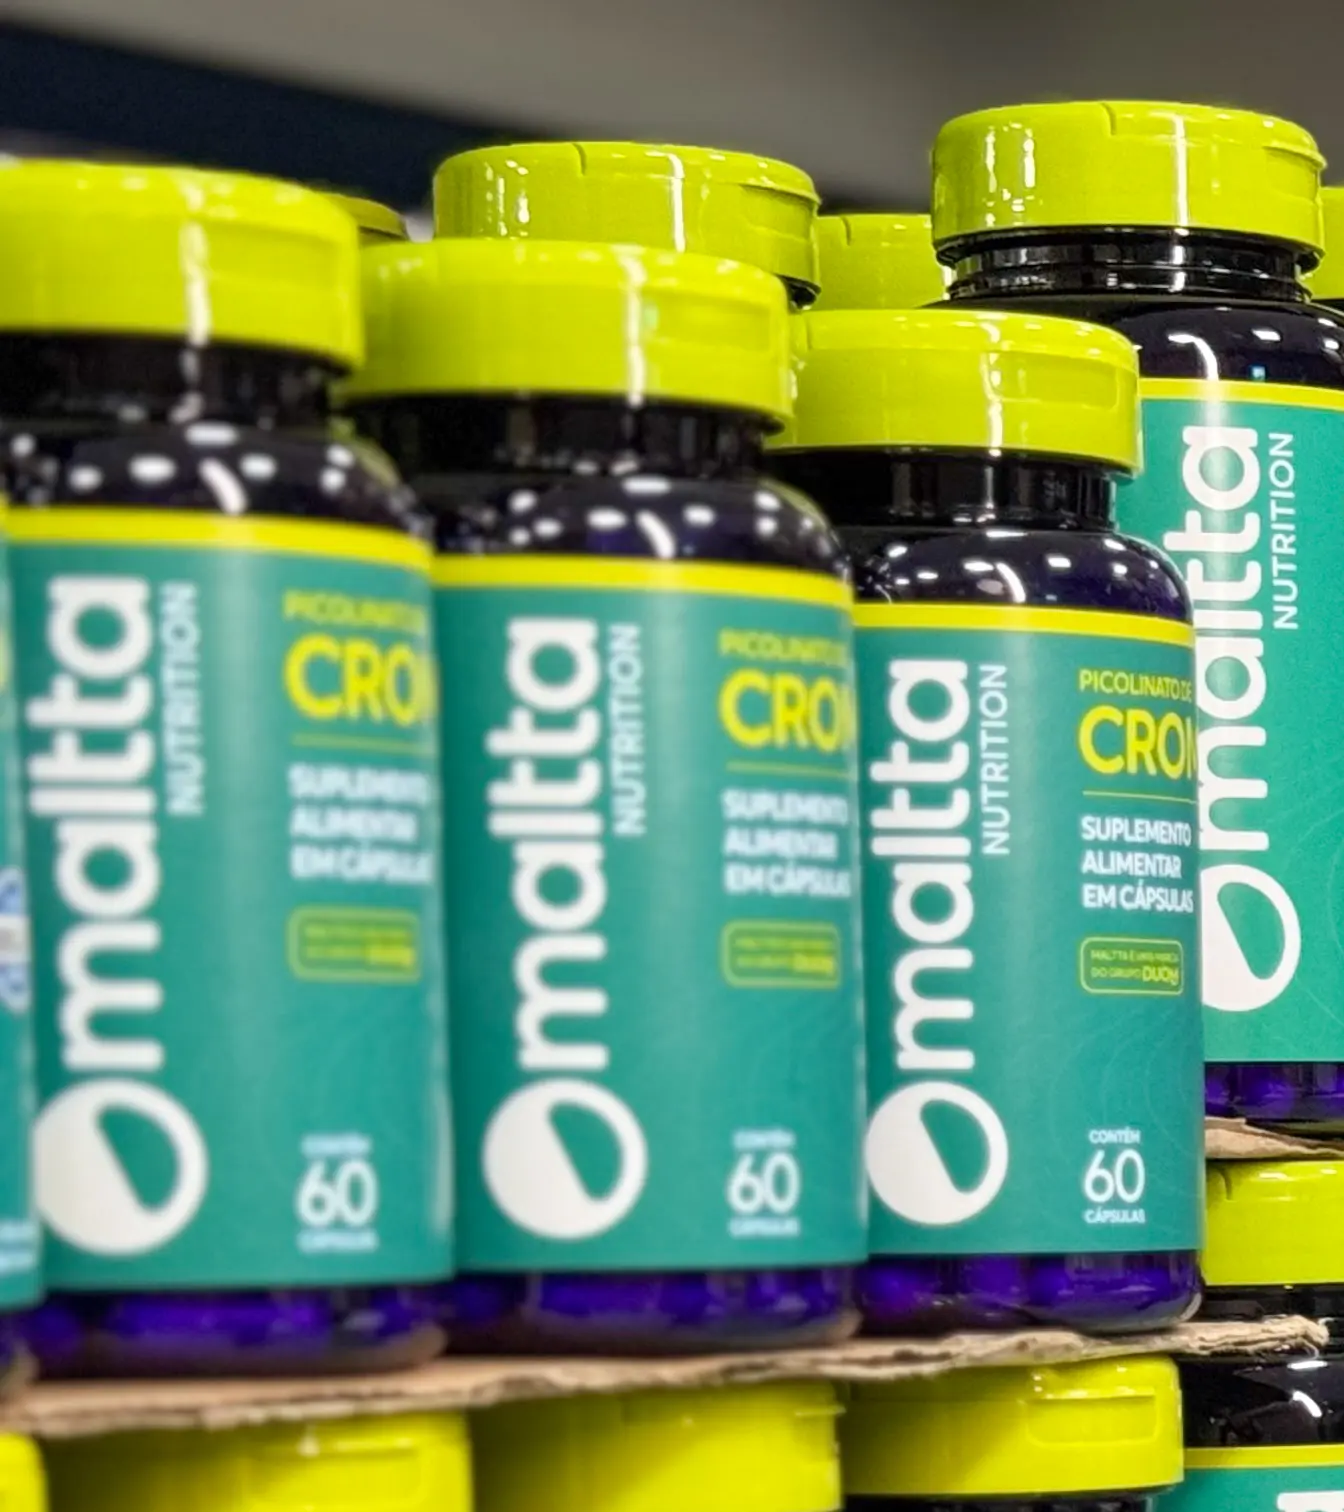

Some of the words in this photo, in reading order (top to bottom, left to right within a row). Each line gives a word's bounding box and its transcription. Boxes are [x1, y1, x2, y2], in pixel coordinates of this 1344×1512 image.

[1270, 431, 1299, 631] NUTRITION
[284, 633, 438, 726] CRO
[1080, 669, 1179, 699] PICOLINATO
[1164, 424, 1268, 851] maltta
[162, 581, 205, 816] NUTRITION
[609, 623, 646, 837] NUTRITION
[718, 668, 856, 751] CRO
[982, 663, 1009, 856] NUTRITION
[26, 577, 163, 1072] maltta
[485, 618, 608, 1070] maltta
[871, 658, 975, 1072] maltta
[1081, 815, 1192, 847] SUPLEMENTO
[1081, 850, 1182, 878] ALIMENTAR
[1082, 883, 1116, 909] EM
[1120, 879, 1193, 913] CÁPSULAS
[295, 1159, 377, 1229] 60
[728, 1152, 801, 1214] 60
[1084, 1149, 1146, 1203] 60
